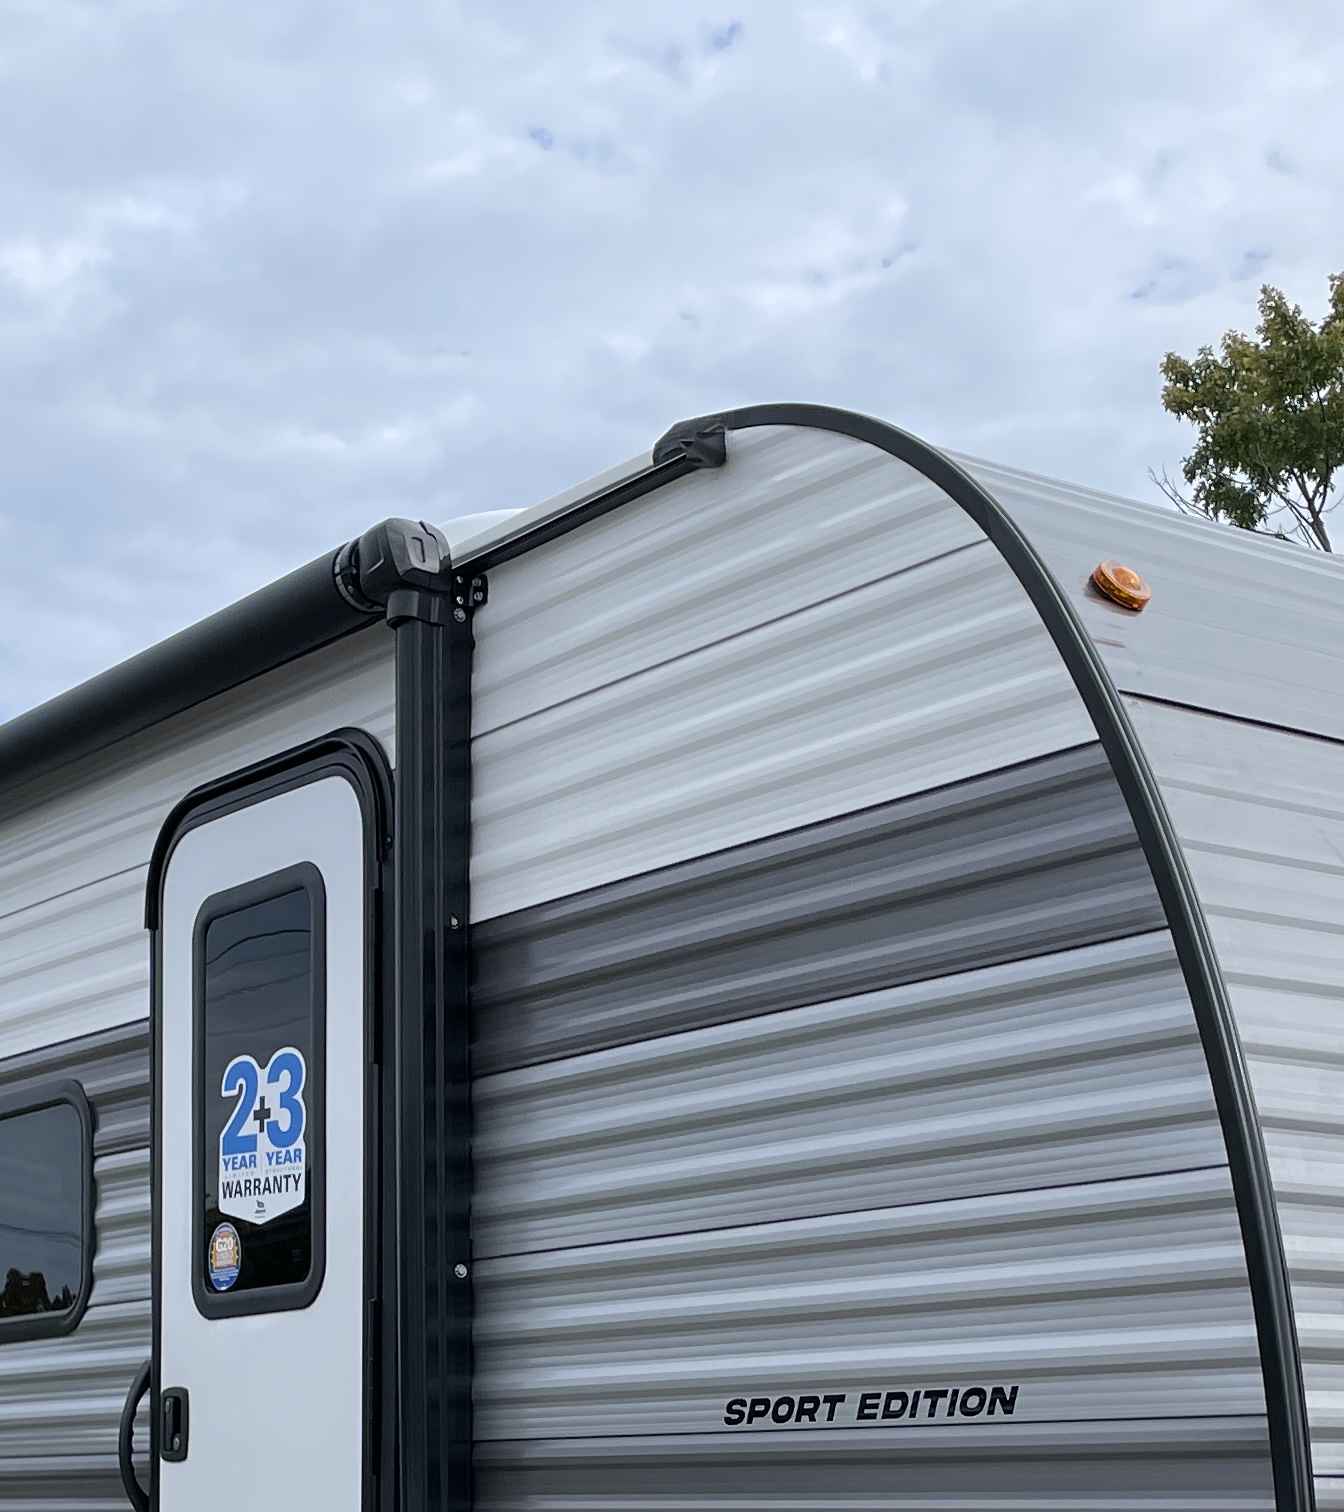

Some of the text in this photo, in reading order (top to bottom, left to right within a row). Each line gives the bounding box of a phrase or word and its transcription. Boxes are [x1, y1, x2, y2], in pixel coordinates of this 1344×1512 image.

[222, 1148, 303, 1172] YEAR YEAR
[222, 1173, 302, 1200] WARRANTY
[724, 1385, 1019, 1425] SPORT EDITION
